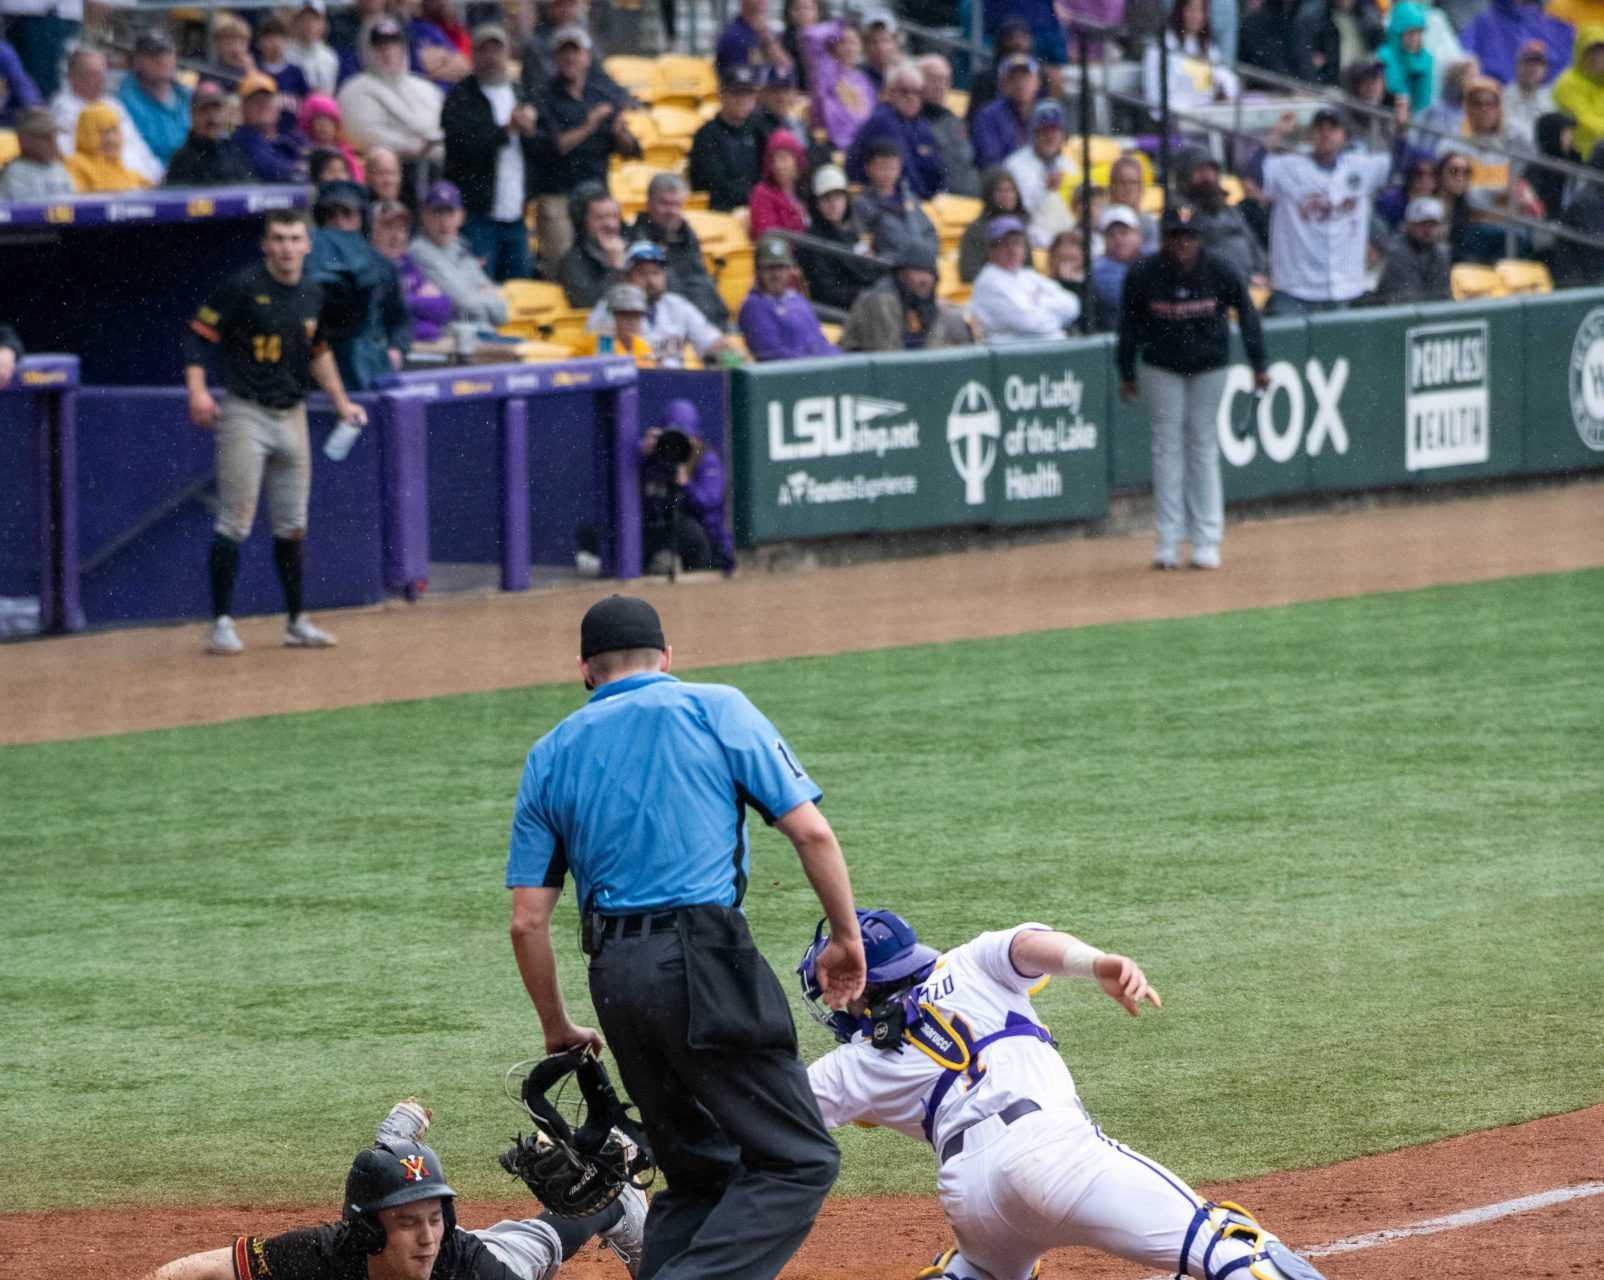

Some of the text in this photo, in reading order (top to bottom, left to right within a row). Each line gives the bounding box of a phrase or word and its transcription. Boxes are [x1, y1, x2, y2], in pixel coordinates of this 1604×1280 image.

[1412, 337, 1483, 388] PEOPLES
[1004, 369, 1083, 415] Our Lady
[1217, 357, 1350, 467] COX
[768, 394, 853, 461] LSU
[1004, 416, 1098, 456] of the Lake
[1415, 407, 1481, 452] HEALTH
[1005, 461, 1062, 501] Health
